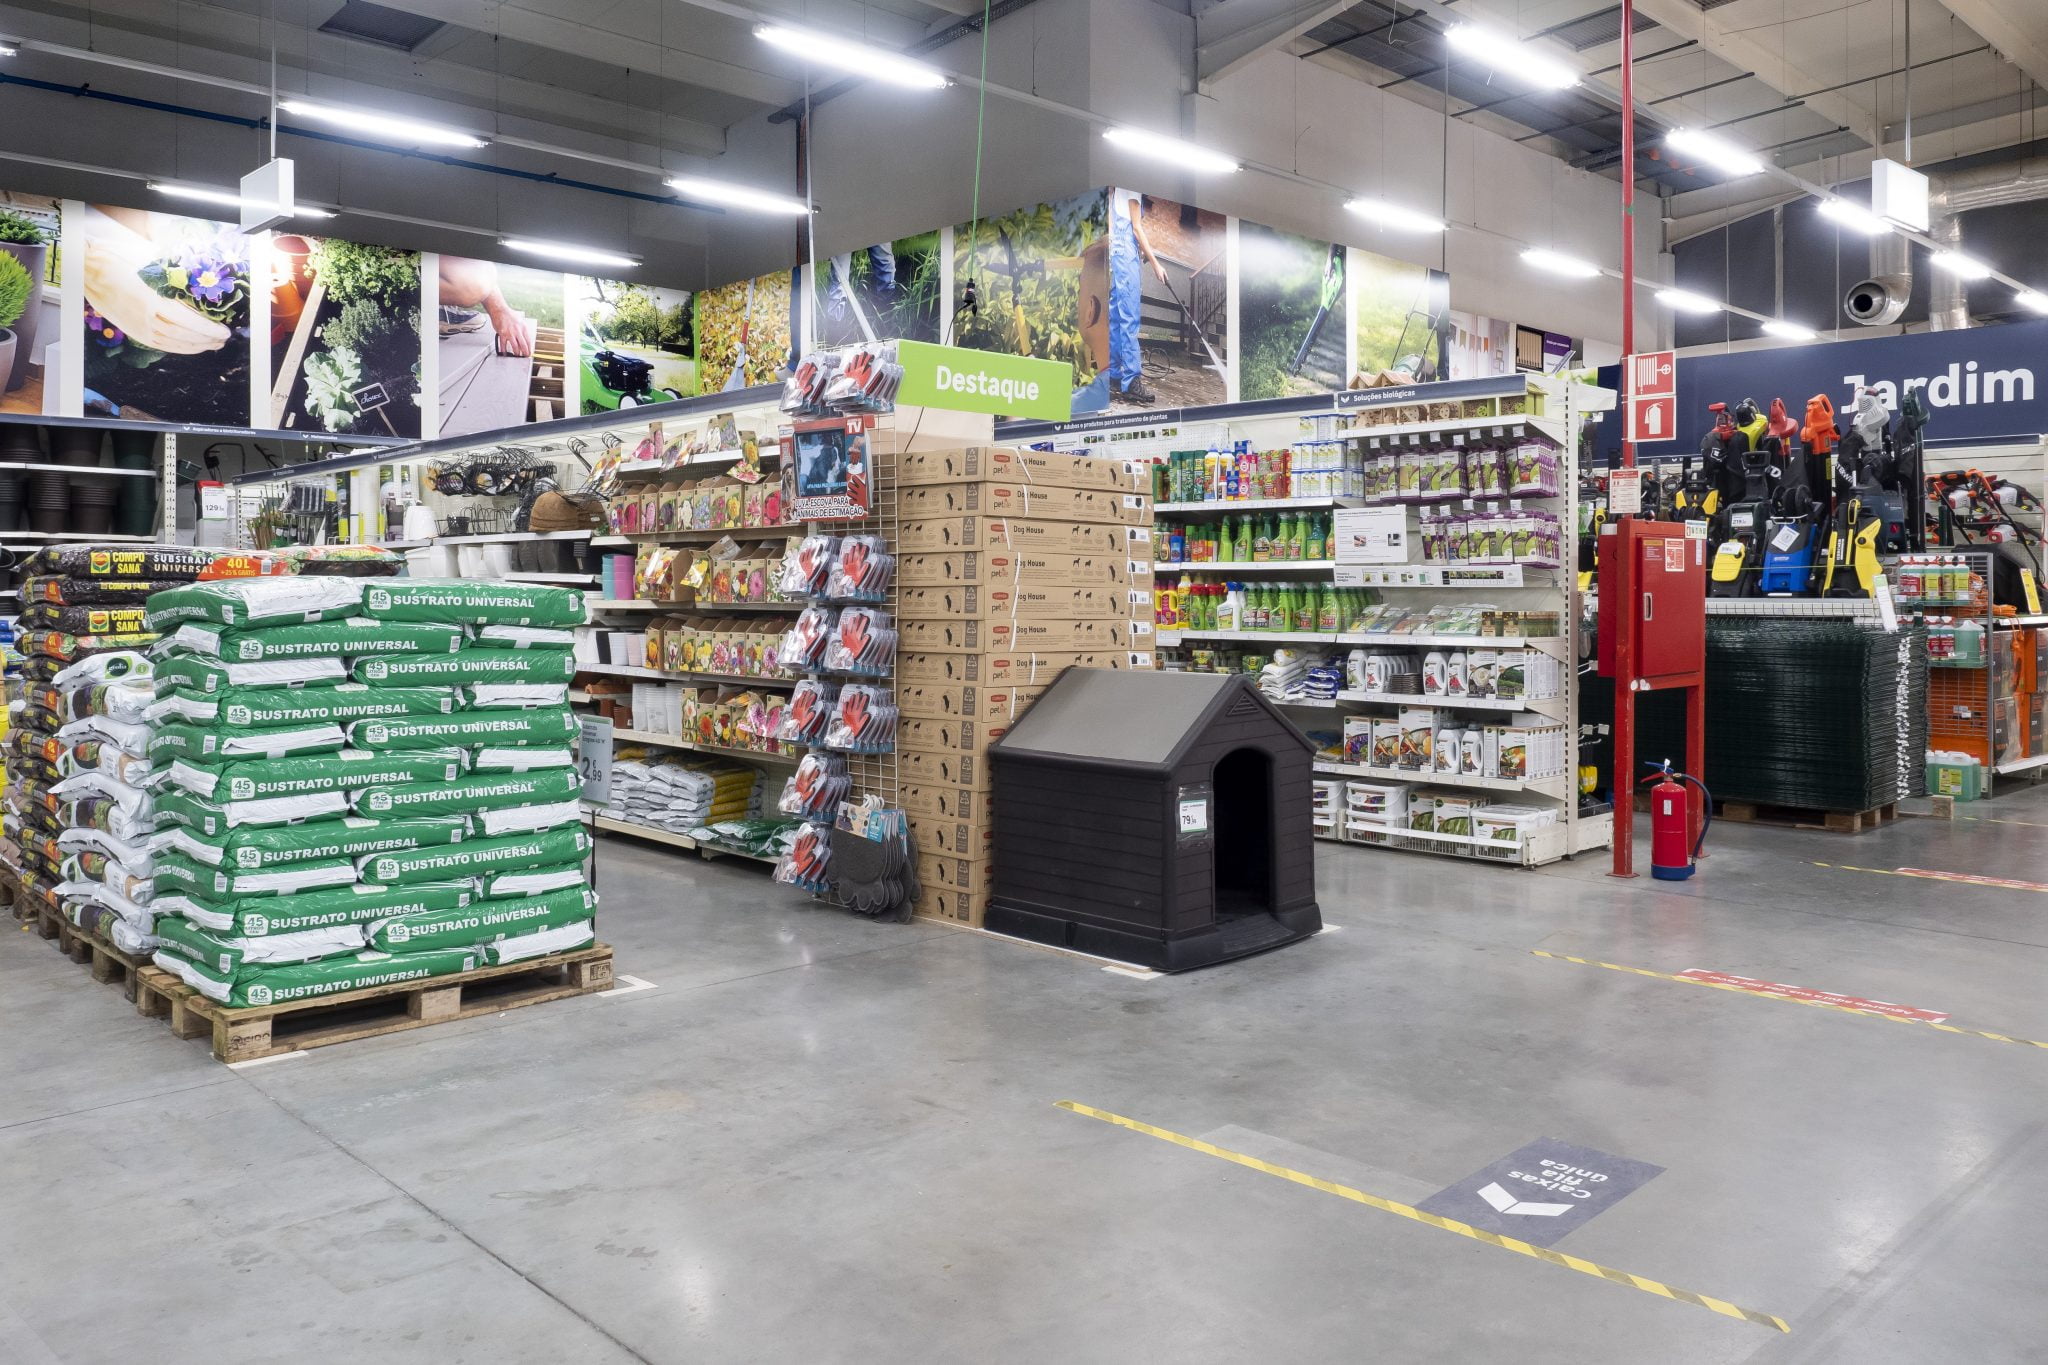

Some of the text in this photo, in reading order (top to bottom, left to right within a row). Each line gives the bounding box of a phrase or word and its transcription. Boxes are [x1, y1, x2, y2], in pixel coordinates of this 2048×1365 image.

[936, 365, 1040, 404] Destaque
[1841, 360, 2034, 414] Jardim
[1354, 390, 1415, 402] Soluções biológicas
[847, 421, 862, 434] TV
[1084, 421, 1104, 429] produtos
[1115, 417, 1143, 425] tratamento
[1150, 414, 1168, 422] plantas
[1029, 458, 1046, 466] House
[834, 496, 850, 506] PARA
[1030, 492, 1048, 500] House
[796, 508, 819, 518] ANIMAIS
[820, 508, 829, 517] DE
[1014, 526, 1025, 535] Dog
[112, 552, 145, 562] COMPO
[154, 553, 214, 565] SUBSTRATO
[1028, 559, 1045, 567] House
[117, 564, 141, 574] SANA
[154, 563, 214, 575] UNIVERSAL
[372, 591, 388, 601] 45
[393, 595, 535, 609] SUSTRATO UNIVERSAL
[1028, 592, 1046, 600] House
[111, 610, 144, 621] COMPO
[116, 621, 141, 632] SANA
[1016, 626, 1027, 635] Dog
[243, 641, 259, 652] 45
[265, 640, 419, 656] SUSTRATO UNIVERSAL
[369, 661, 384, 671] 45
[389, 661, 531, 674] SUSTRATO UNIVERSAL
[1016, 659, 1028, 668] Dog
[230, 707, 247, 719] 45
[253, 704, 410, 721] SUSTRATO UNIVERSAL
[369, 725, 384, 735] 45
[390, 721, 531, 737] SUSTRATO UNIVERSAL
[234, 780, 251, 791] 45
[257, 771, 414, 793] SUSTRATO UNIVERSAL
[372, 794, 389, 802] 45
[394, 783, 535, 805] SUSTRATO UNIVERSAL
[239, 850, 257, 861] 45
[263, 838, 419, 862] SUSTRATO UNIVERSAL
[401, 846, 543, 872] SUSTRATO UNIVERSAL
[379, 861, 395, 871] 45
[247, 916, 264, 928] 45
[271, 903, 427, 930] SUSTRATO UNIVERSAL
[411, 905, 551, 936] SUSTRATO UNIVERSAL
[389, 925, 406, 936] 45
[274, 968, 431, 1000] SUSTRATO UNIVERSAL
[250, 986, 267, 998] 45
[1539, 1158, 1609, 1182] única
[1507, 1170, 1592, 1199] Caixas
